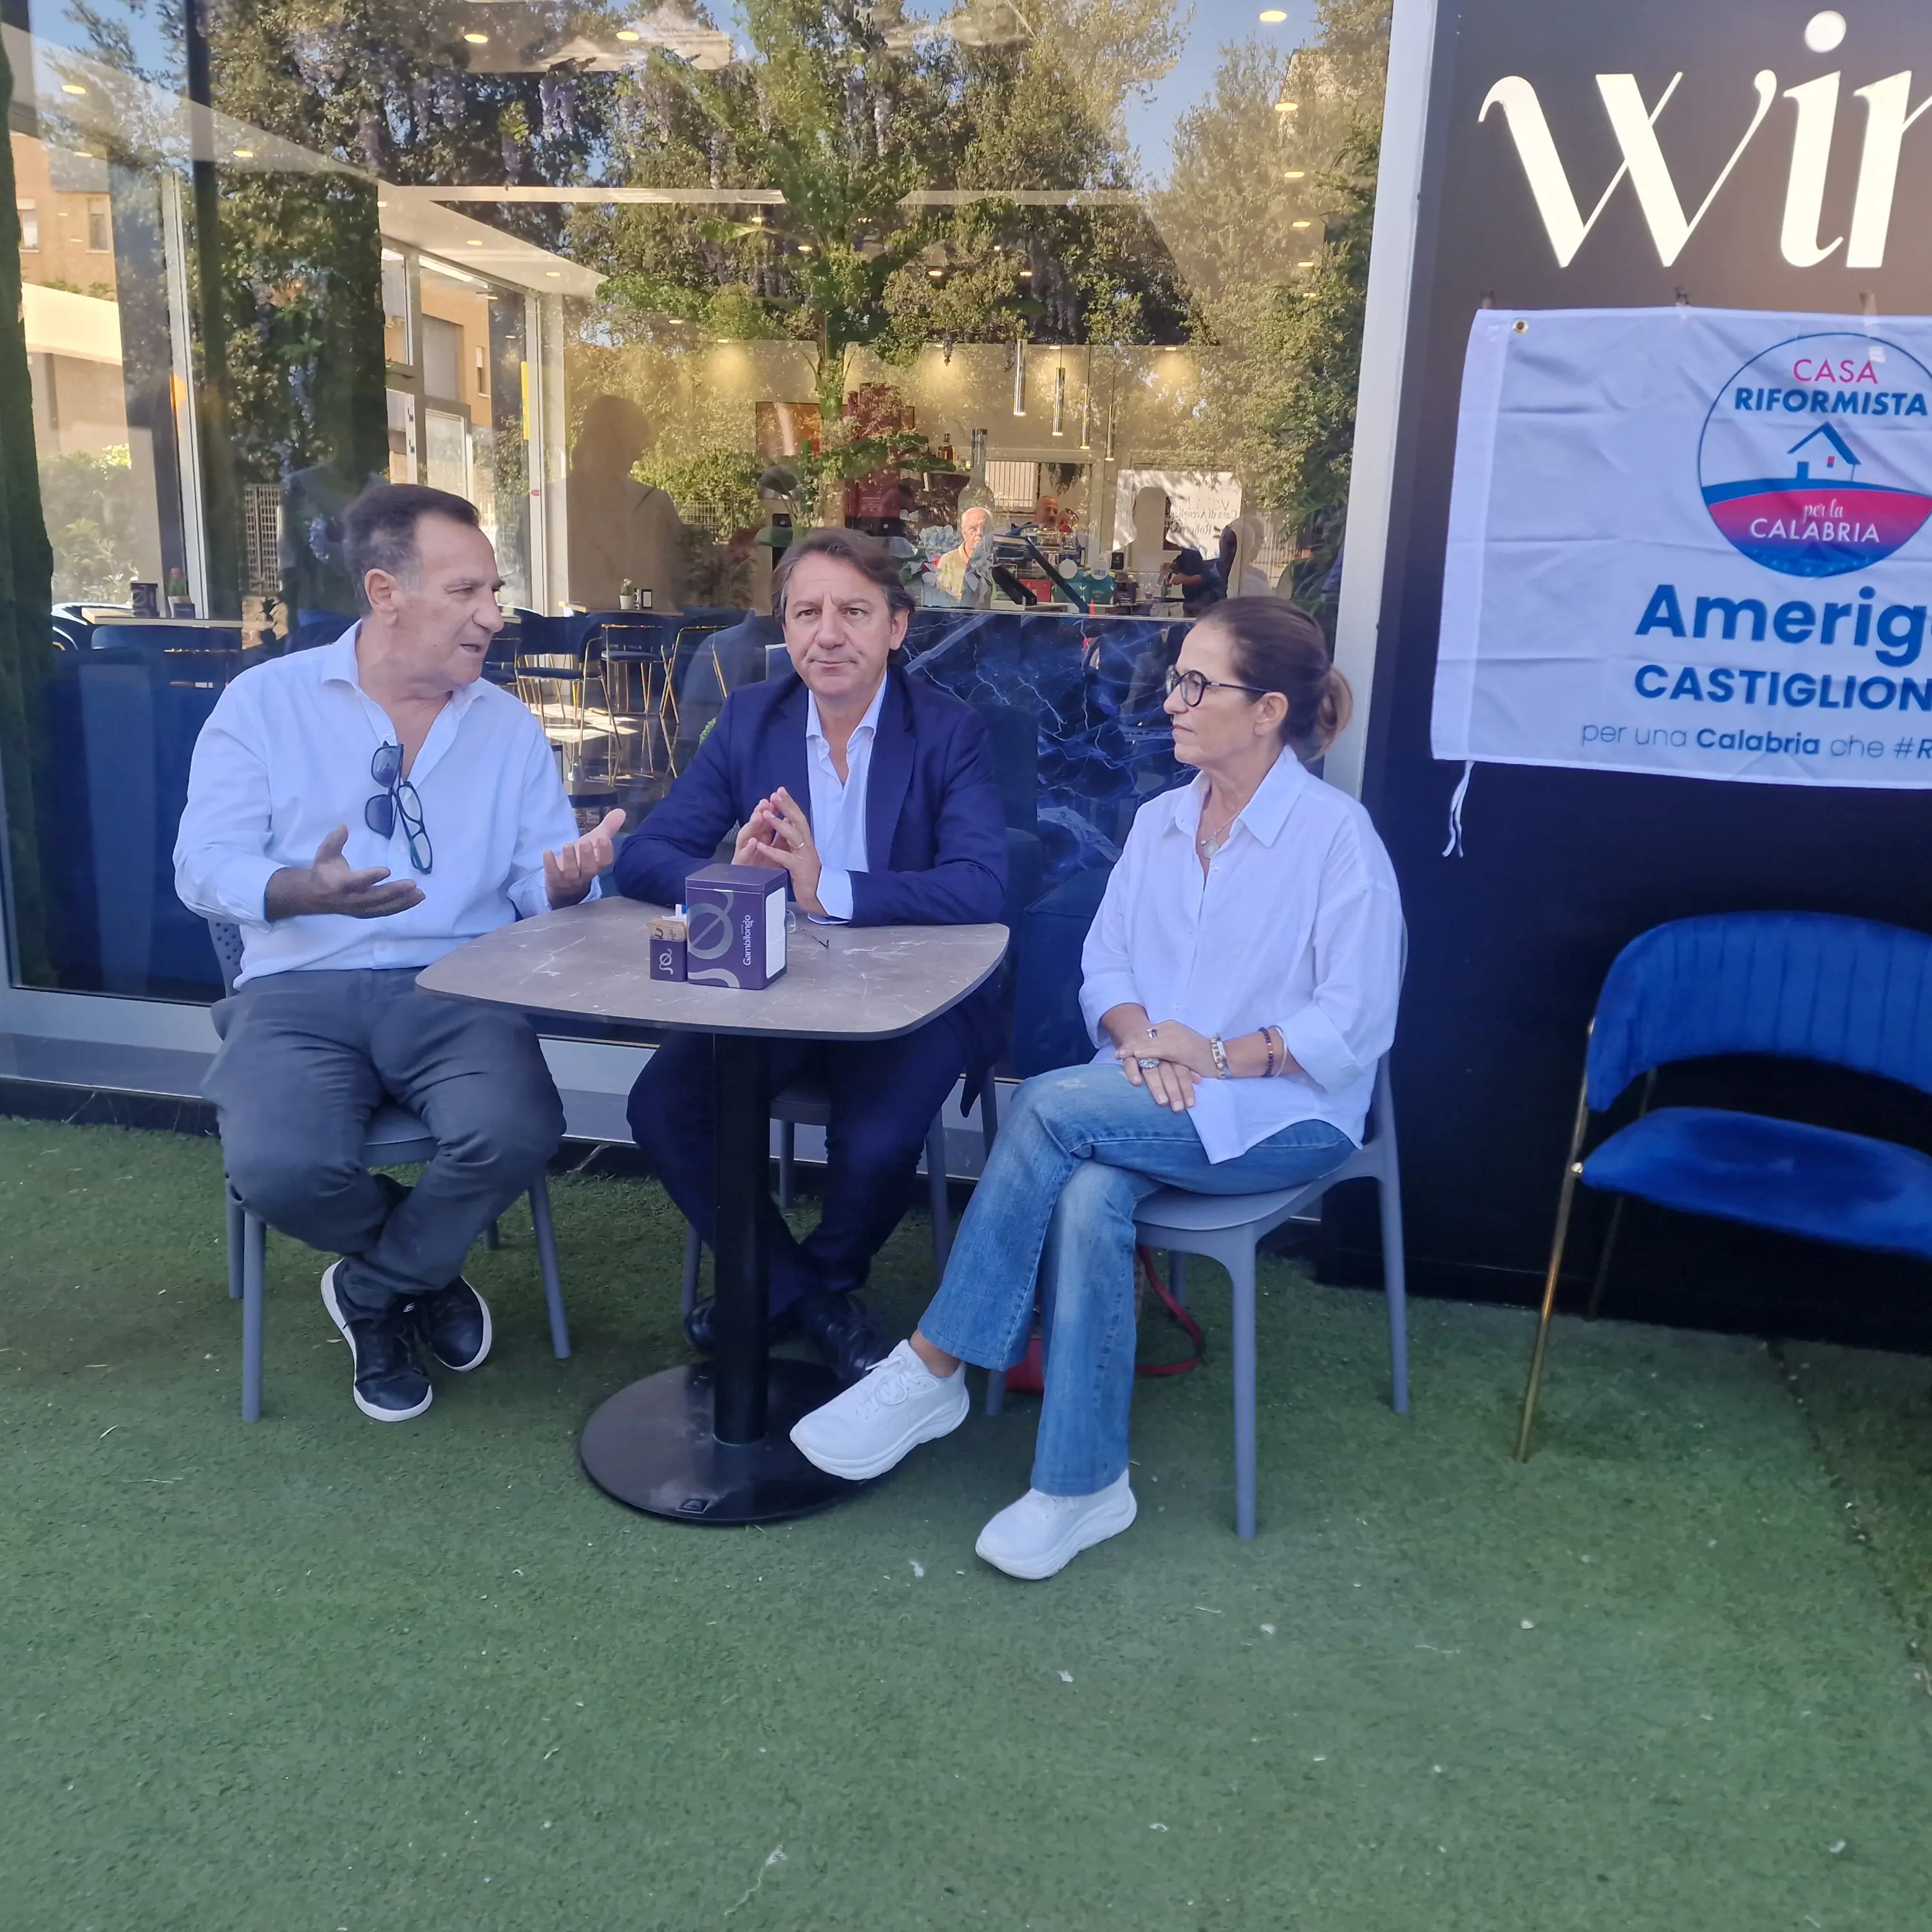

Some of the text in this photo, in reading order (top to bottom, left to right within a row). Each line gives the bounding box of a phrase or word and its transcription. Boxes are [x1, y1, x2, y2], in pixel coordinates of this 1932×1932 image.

[1793, 359, 1879, 384] CASA
[1734, 387, 1928, 416] RIFORMISTA
[1803, 498, 1844, 524] per la
[1750, 518, 1880, 544] CALABRIA
[1634, 584, 1932, 667] Amerig
[1634, 665, 1932, 712] CASTIGLION
[1582, 723, 1627, 746] per
[1635, 728, 1687, 747] una
[1696, 728, 1821, 755] Calabria
[1831, 735, 1884, 758] che
